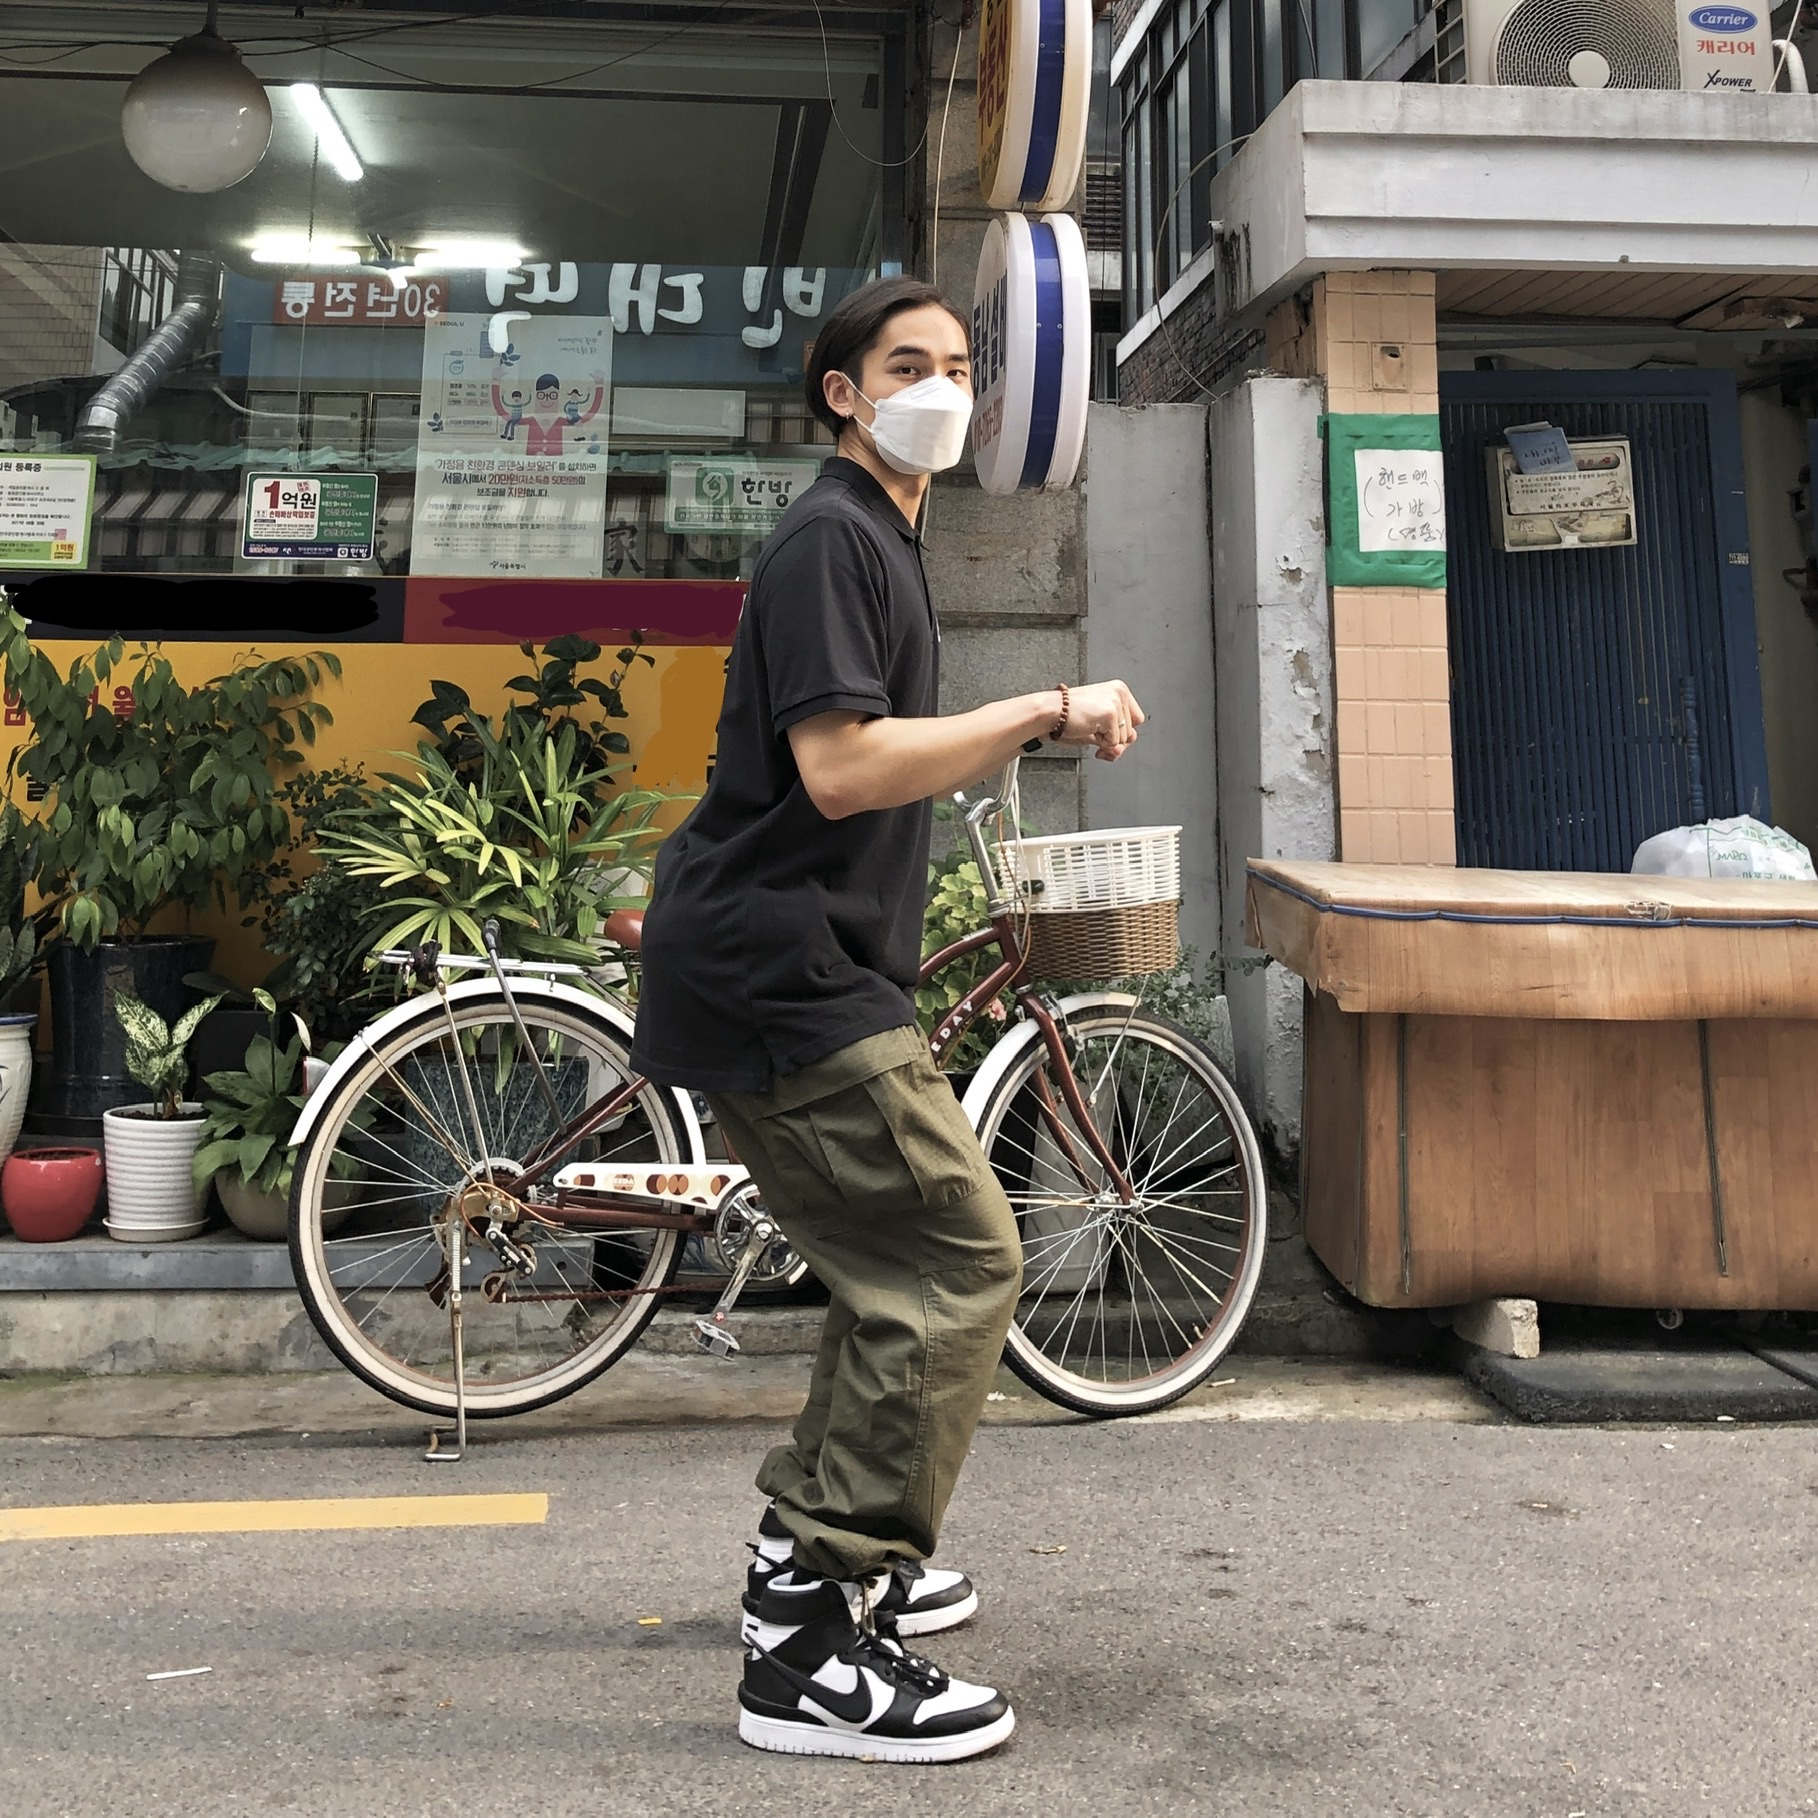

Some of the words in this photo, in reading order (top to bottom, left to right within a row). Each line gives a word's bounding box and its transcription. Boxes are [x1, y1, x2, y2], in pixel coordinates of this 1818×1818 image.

[1699, 11, 1748, 25] Carrier
[1696, 39, 1756, 55] 캐리어
[15, 462, 42, 473] 등록증
[467, 460, 495, 471] 친환경
[442, 472, 486, 485] 서울시에서
[264, 481, 317, 510] 1억원
[476, 487, 505, 497] 보조금을
[742, 477, 792, 508] 한방
[1386, 498, 1424, 518] 가방
[604, 517, 645, 576] 家
